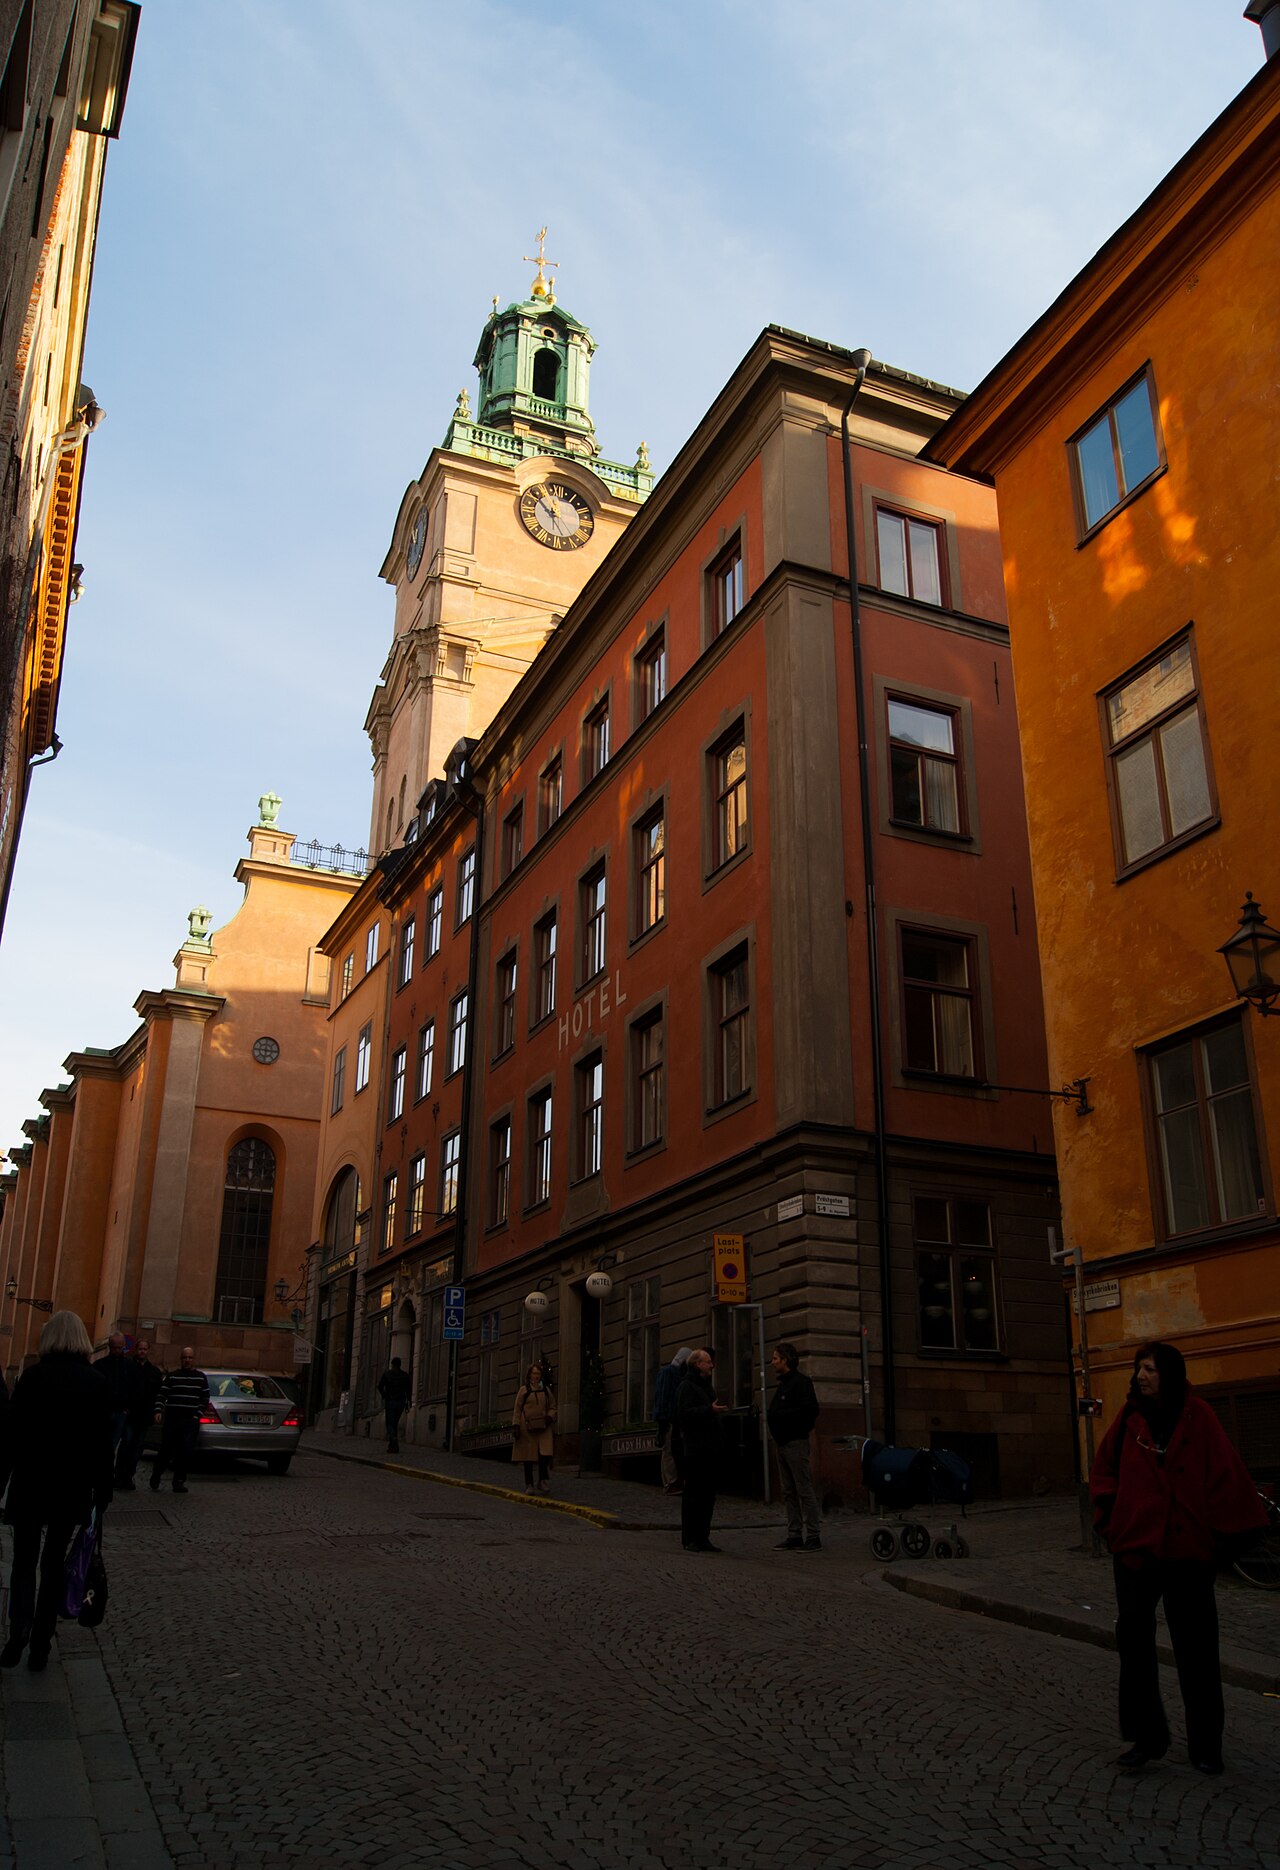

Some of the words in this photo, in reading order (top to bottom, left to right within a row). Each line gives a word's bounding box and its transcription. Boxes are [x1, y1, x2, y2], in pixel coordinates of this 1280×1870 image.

[558, 969, 627, 1051] HOTEL
[717, 1238, 740, 1246] Last-
[718, 1247, 740, 1255] plats
[592, 1278, 610, 1287] HOTEL
[720, 1288, 737, 1297] 0-10
[450, 1289, 462, 1306] P
[530, 1298, 545, 1306] HOTEL
